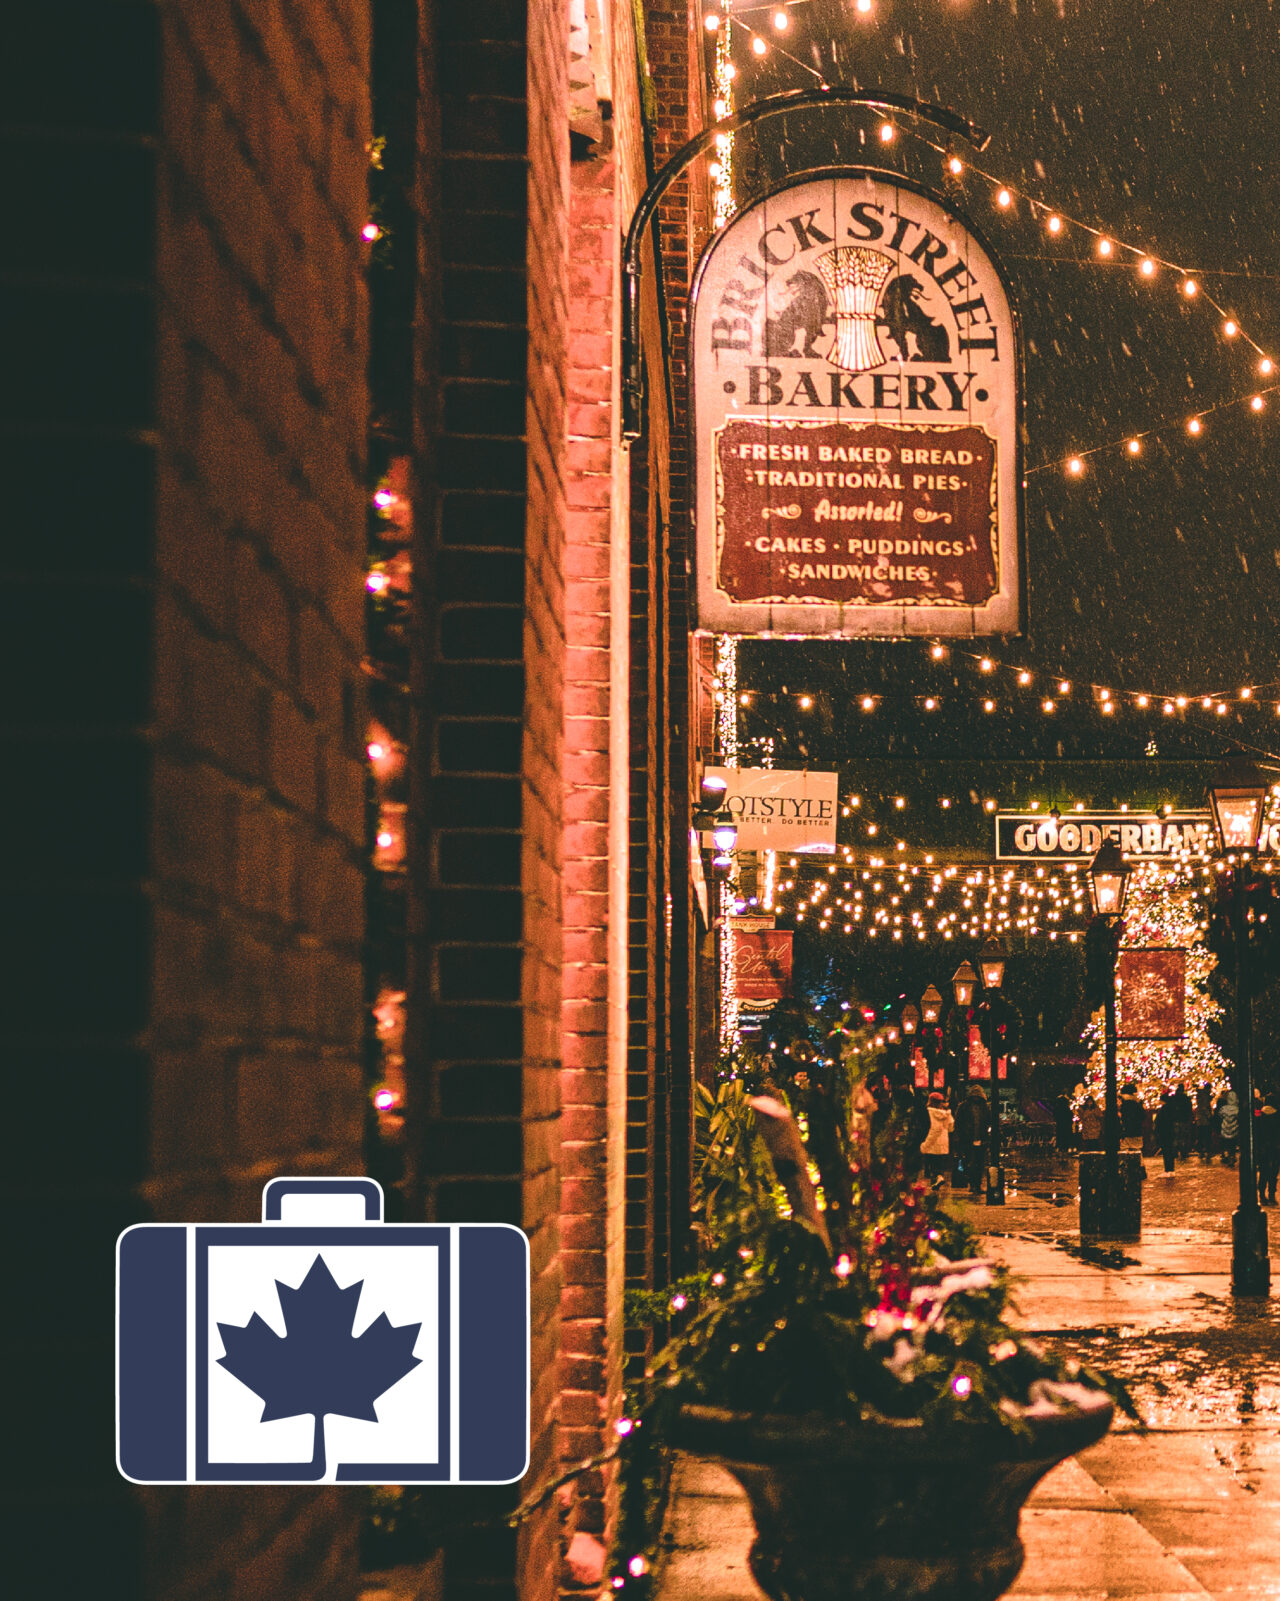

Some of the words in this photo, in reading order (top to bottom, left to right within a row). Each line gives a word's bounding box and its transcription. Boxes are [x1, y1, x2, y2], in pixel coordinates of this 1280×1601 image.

[711, 208, 835, 353] BRICK
[847, 202, 999, 361] STREET
[744, 365, 978, 412] BAKERY
[739, 444, 809, 461] FRESH
[818, 446, 892, 463] BAKED
[901, 448, 973, 465] BREAD
[755, 470, 905, 490] TRADITIONAL
[913, 474, 961, 491] PIES
[814, 498, 904, 523] Assorted!
[754, 536, 826, 554] CAKES
[848, 539, 964, 557] PUDDINGS
[787, 564, 931, 582] SANDWICHES
[722, 795, 833, 819] OTSTYLE
[1014, 823, 1207, 852] GOODERHAM
